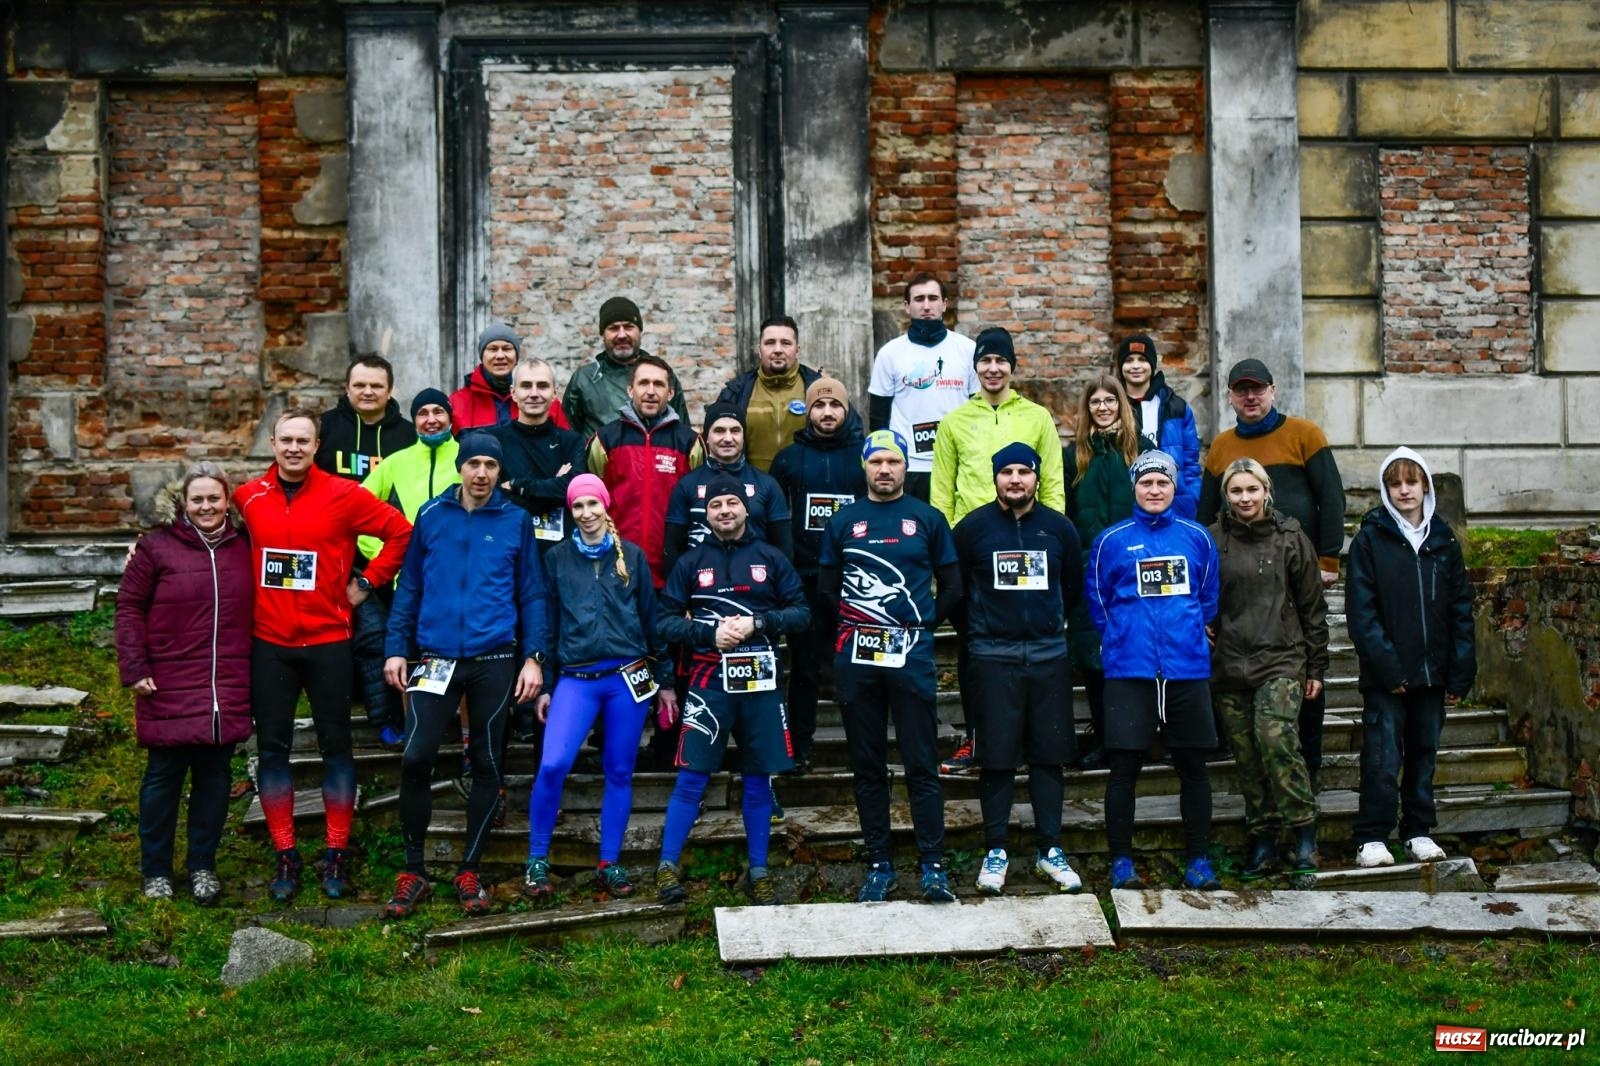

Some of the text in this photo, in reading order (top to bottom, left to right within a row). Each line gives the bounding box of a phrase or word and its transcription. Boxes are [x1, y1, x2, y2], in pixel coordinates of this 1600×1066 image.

[915, 430, 937, 442] 004
[810, 505, 833, 517] 005
[266, 561, 283, 574] 011
[998, 561, 1019, 573] 012
[1141, 569, 1162, 583] 013
[858, 634, 881, 649] 002
[629, 668, 650, 685] 008
[728, 665, 752, 678] 003
